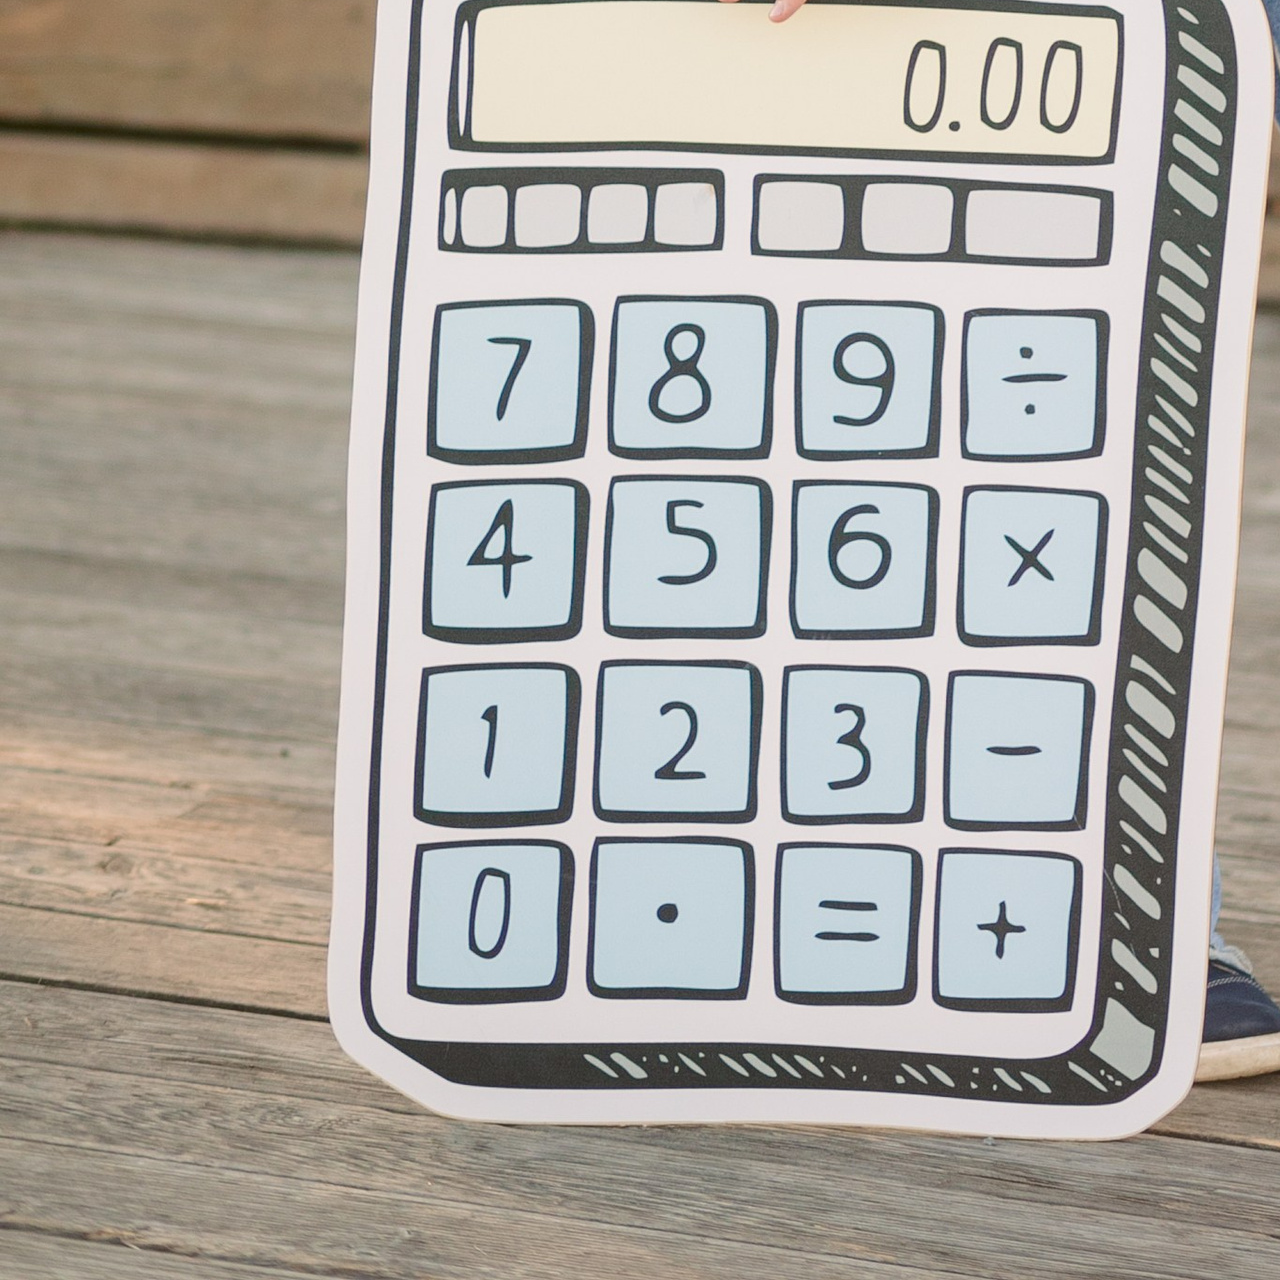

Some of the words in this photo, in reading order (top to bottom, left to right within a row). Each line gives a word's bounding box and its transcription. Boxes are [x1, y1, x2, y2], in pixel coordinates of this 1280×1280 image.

[903, 37, 1083, 134] 0.00
[487, 336, 532, 422] 7
[648, 323, 712, 424] 8
[832, 332, 896, 427] 9
[466, 498, 533, 599] 4
[657, 499, 718, 586] 5
[827, 504, 892, 590] 6
[480, 704, 498, 779] 1
[654, 701, 707, 781] 2
[827, 703, 872, 791] 3
[468, 867, 511, 960] 0
